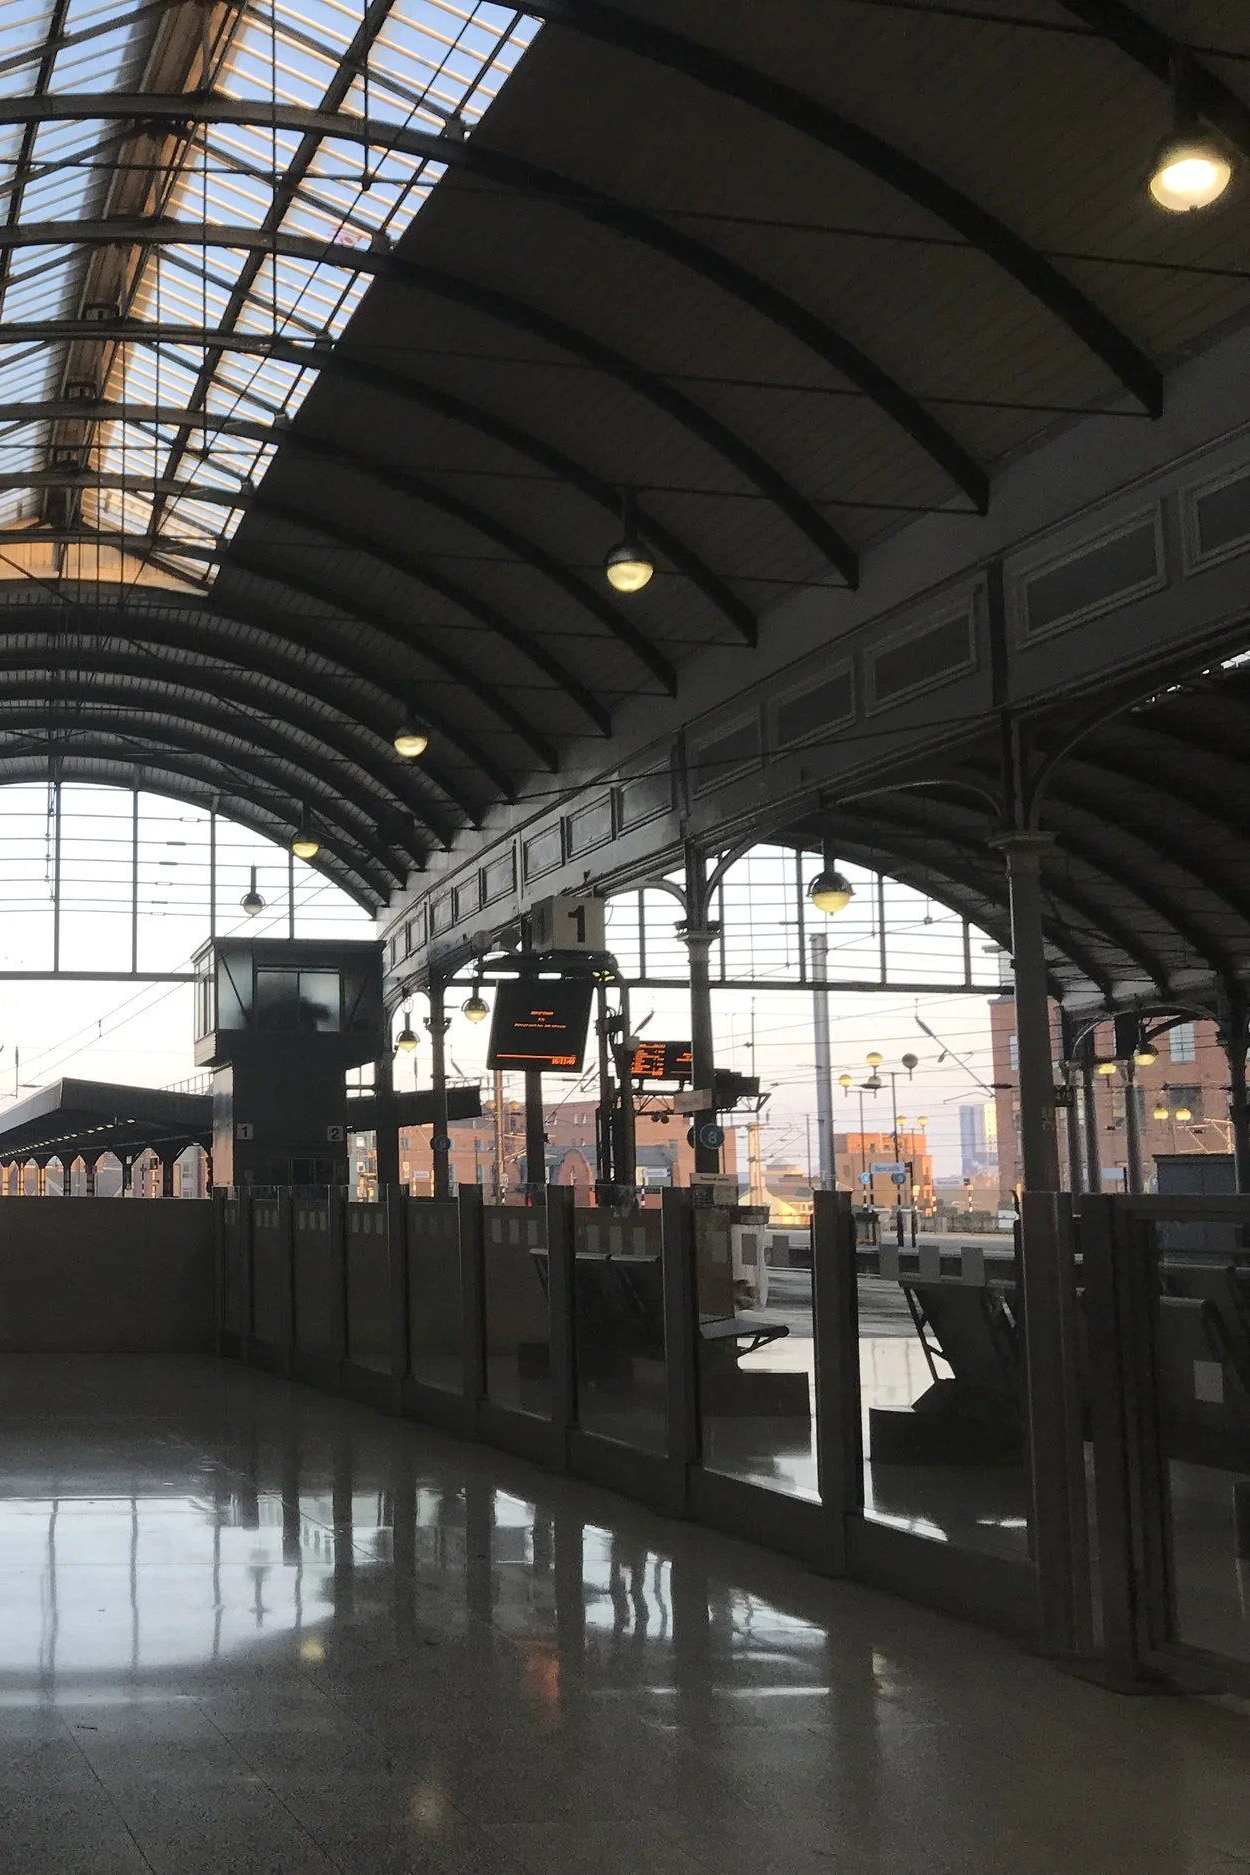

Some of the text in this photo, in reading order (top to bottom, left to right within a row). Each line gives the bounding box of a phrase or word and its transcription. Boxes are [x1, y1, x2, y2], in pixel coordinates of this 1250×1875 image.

[568, 905, 585, 942] 1
[241, 1126, 248, 1137] 1
[330, 1128, 340, 1139] 2
[708, 1131, 717, 1143] 8
